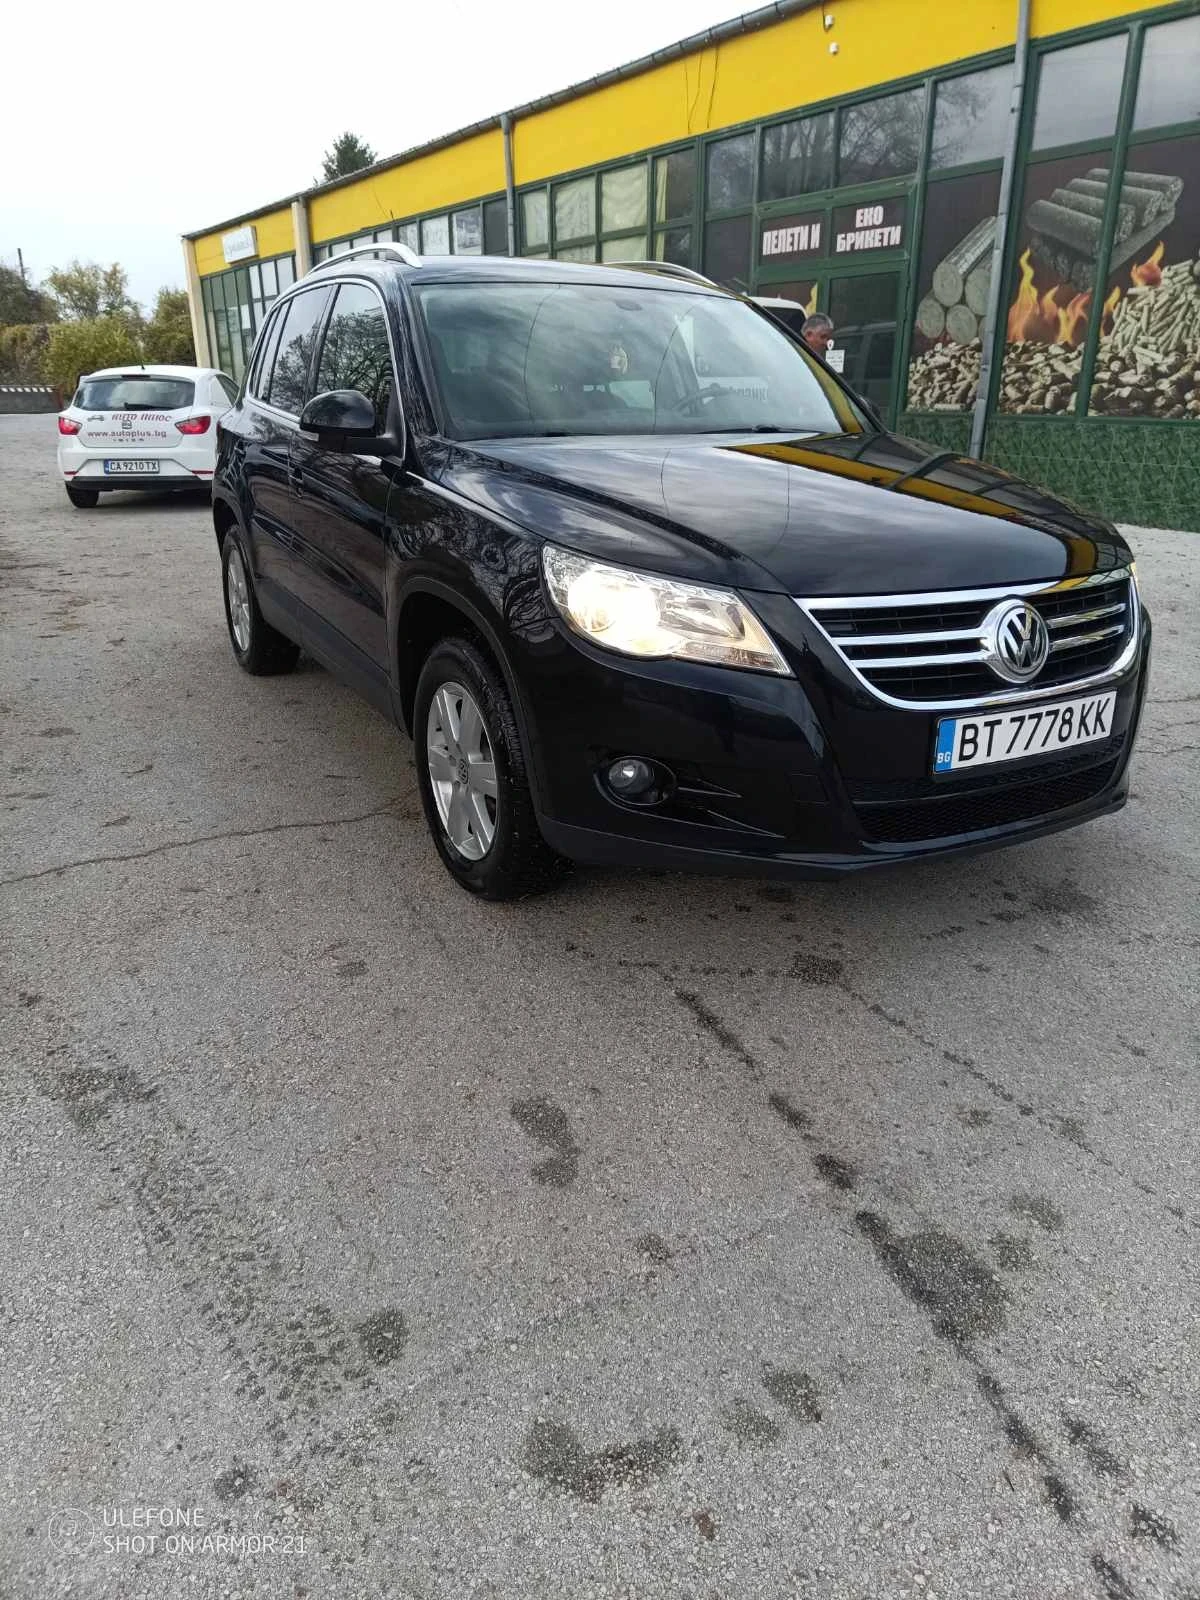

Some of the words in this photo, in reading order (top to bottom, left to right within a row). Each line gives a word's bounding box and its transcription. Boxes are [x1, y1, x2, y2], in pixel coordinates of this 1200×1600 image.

[855, 205, 884, 228] ЕКО
[762, 225, 809, 256] ПЕЛЕТИ
[810, 223, 821, 249] И
[836, 225, 901, 252] БРИКЕТИ
[88, 430, 167, 438] www.autoplus.bg
[937, 752, 951, 764] BG
